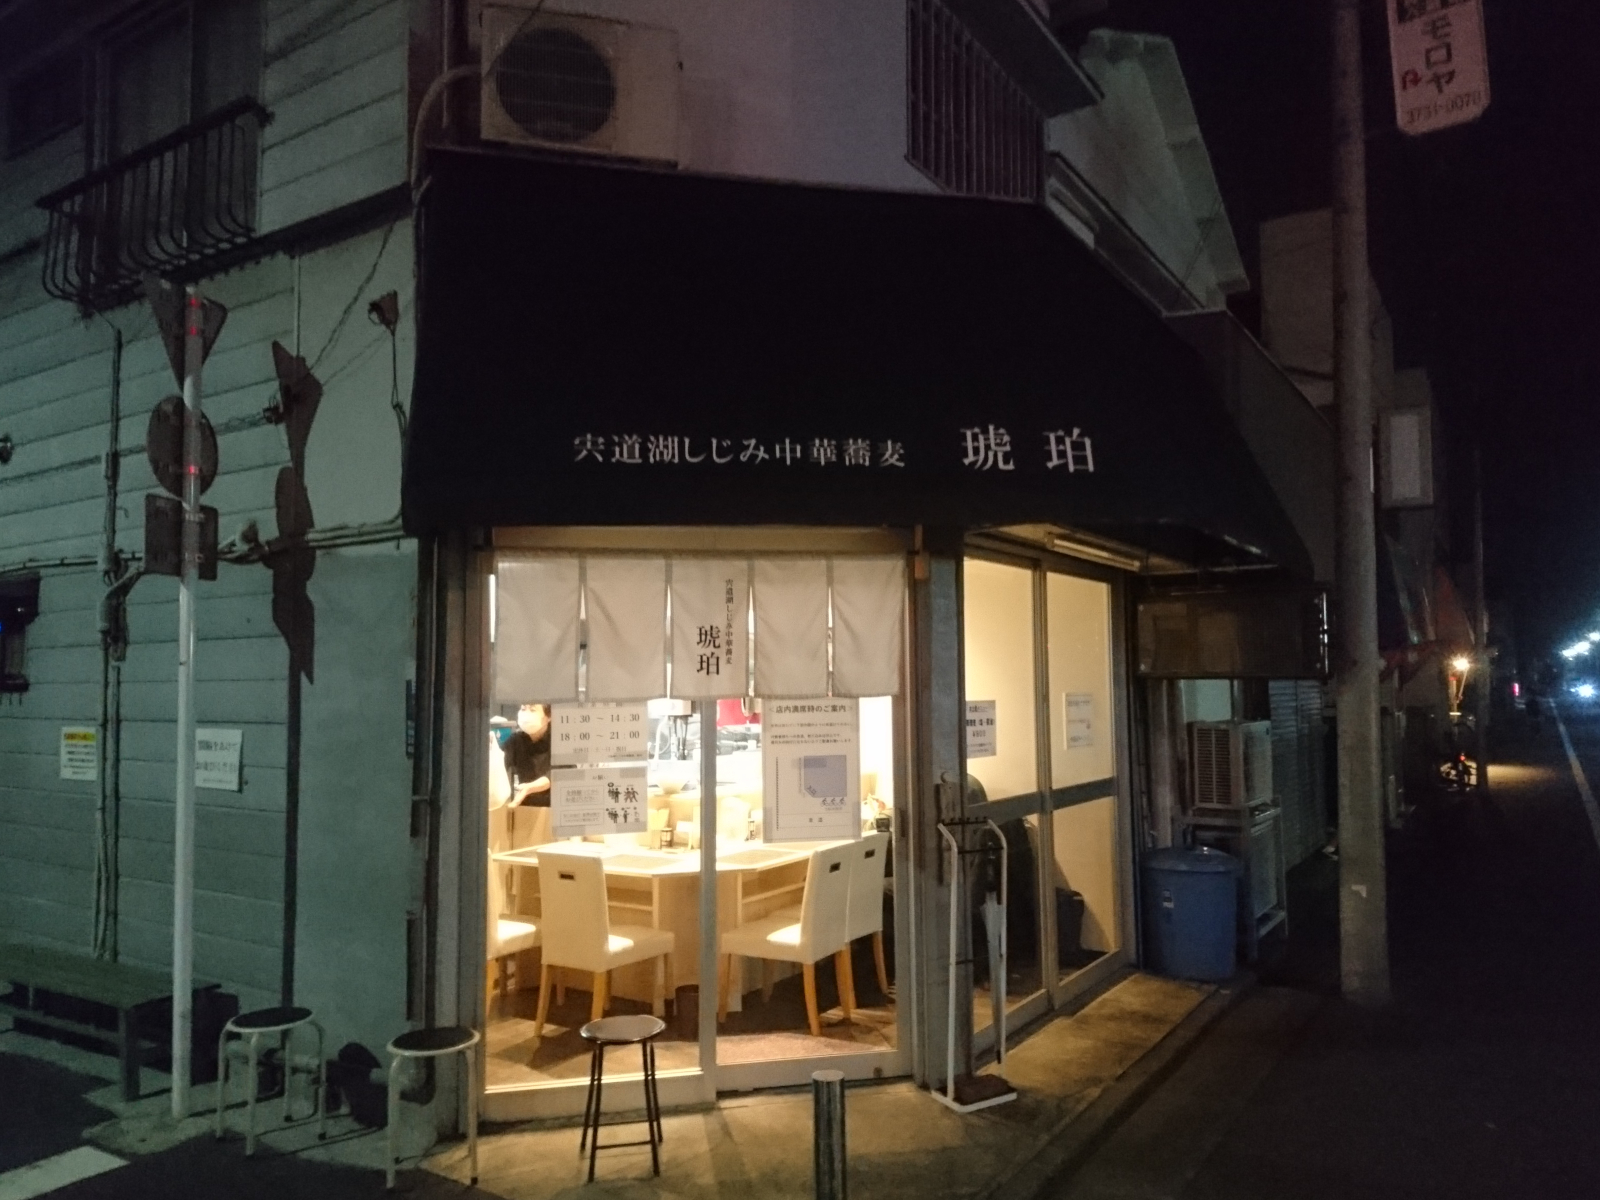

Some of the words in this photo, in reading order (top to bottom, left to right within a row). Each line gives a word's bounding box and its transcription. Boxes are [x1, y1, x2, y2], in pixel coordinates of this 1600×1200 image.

[572, 431, 906, 469] 宍道湖しじみ中華蕎麦
[959, 423, 1097, 474] 琥珀
[696, 624, 721, 676] 琥珀
